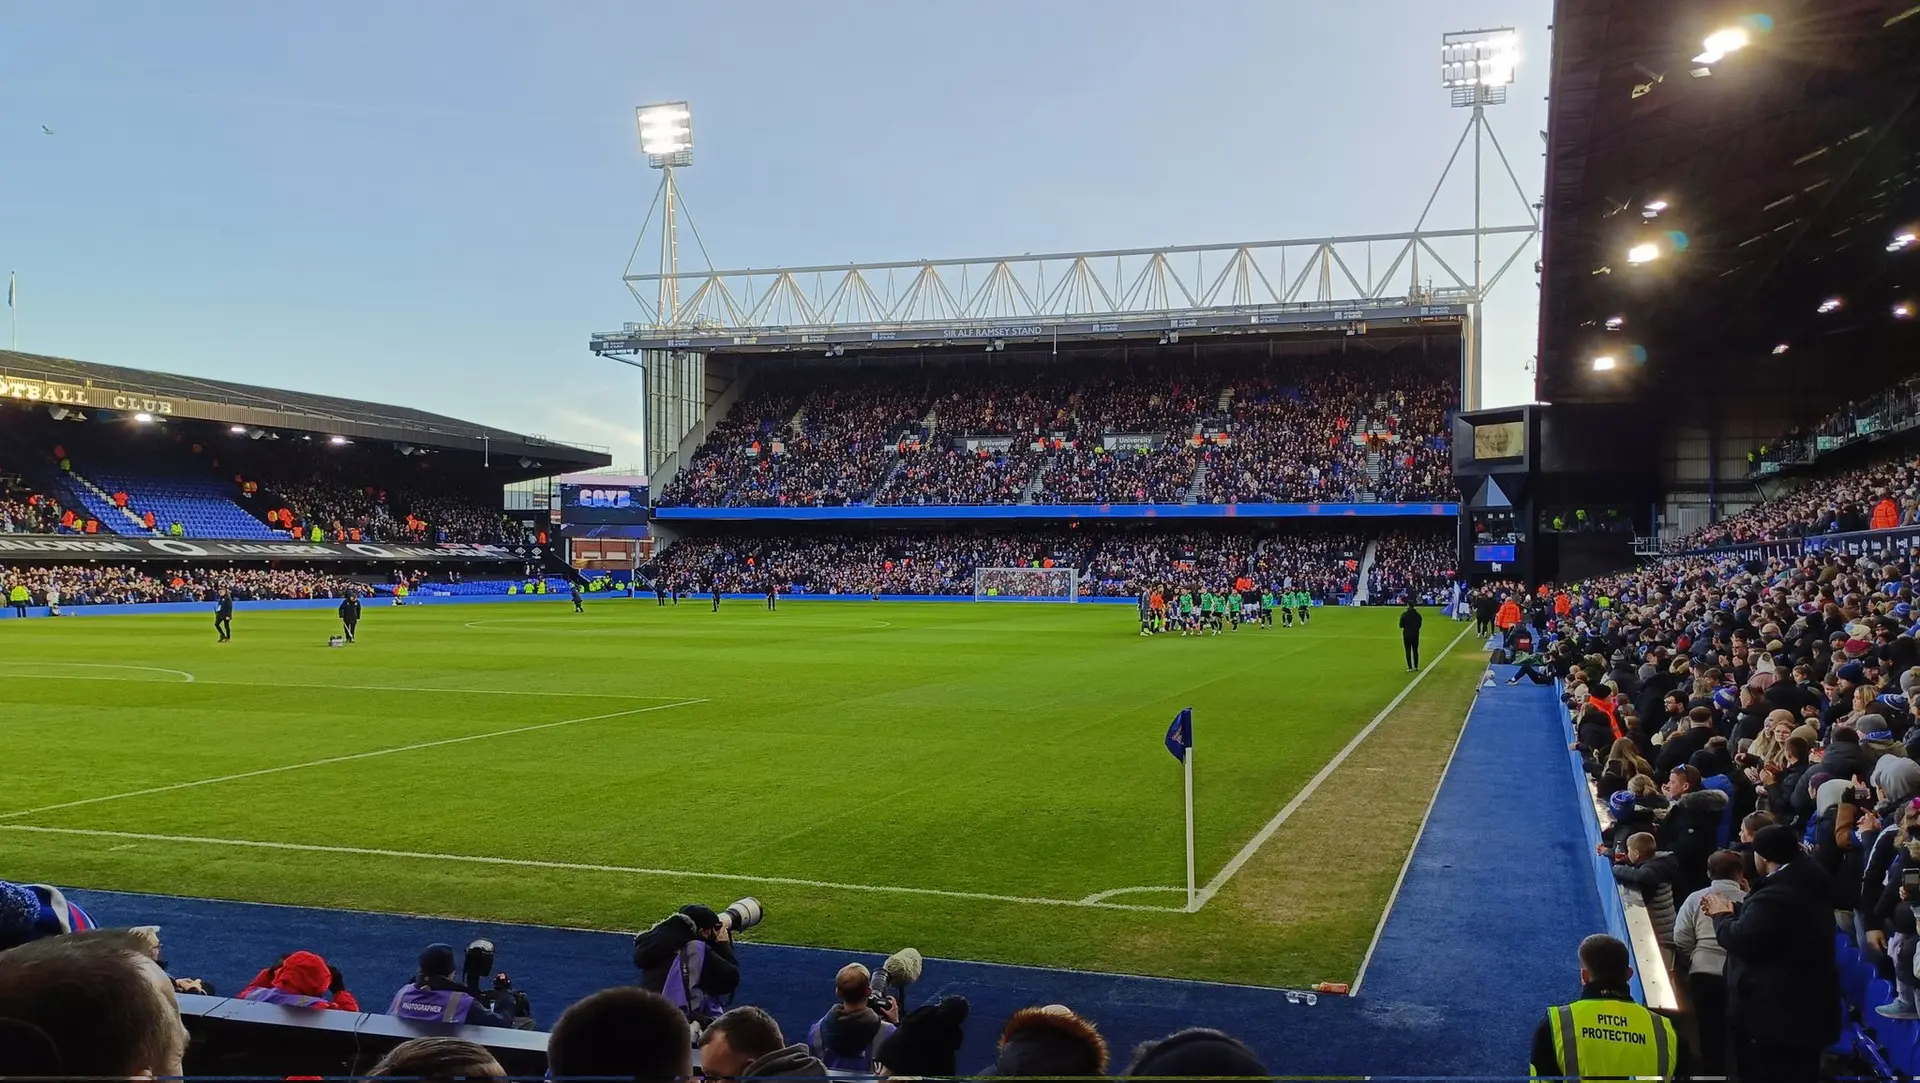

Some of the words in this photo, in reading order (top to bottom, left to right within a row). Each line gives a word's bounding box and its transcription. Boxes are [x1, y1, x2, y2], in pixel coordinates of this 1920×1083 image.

[943, 330, 956, 338] SIR
[957, 329, 974, 337] ALF
[975, 328, 1010, 337] RAMSEY
[1012, 326, 1042, 336] STAND
[113, 396, 172, 414] CLUB
[981, 440, 1011, 448] University
[1119, 437, 1152, 445] University
[402, 1002, 442, 1013] PHOTOGRAPHER
[1597, 1014, 1628, 1027] PITCH
[1582, 1028, 1646, 1045] PROTECTION
